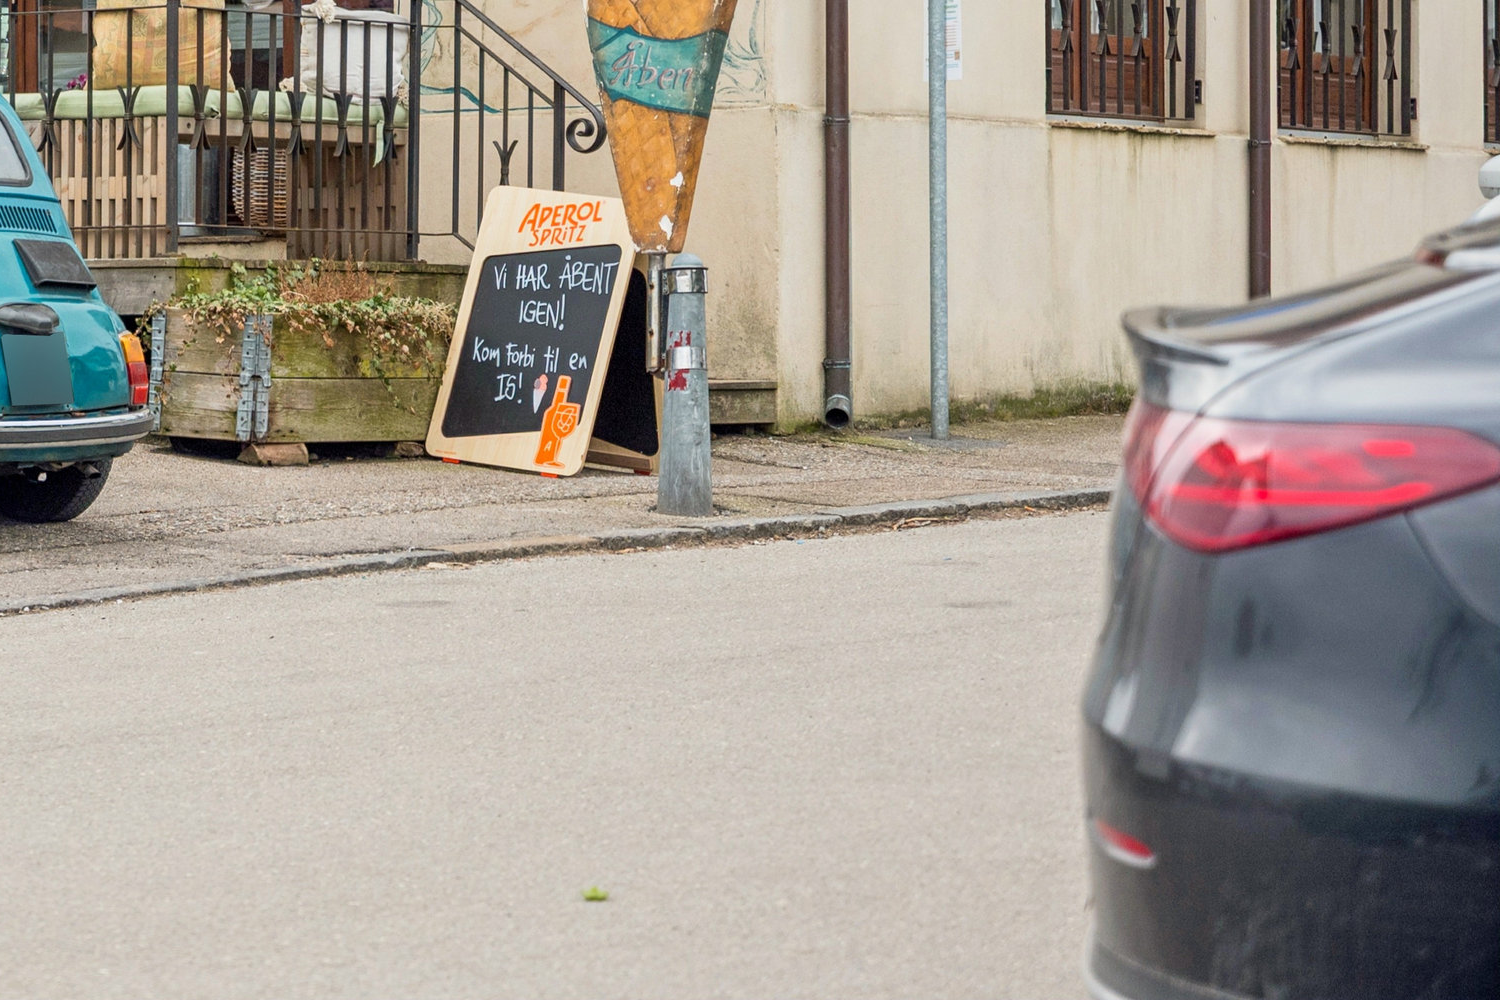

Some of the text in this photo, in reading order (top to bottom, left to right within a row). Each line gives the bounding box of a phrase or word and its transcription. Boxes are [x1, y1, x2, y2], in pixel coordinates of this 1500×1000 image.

[517, 200, 603, 234] APEROL
[515, 263, 551, 292] HAR
[558, 254, 620, 296] ÅBENT
[518, 293, 566, 331] IGEN!
[472, 336, 500, 368] Kom
[543, 345, 560, 374] til
[568, 352, 588, 370] en
